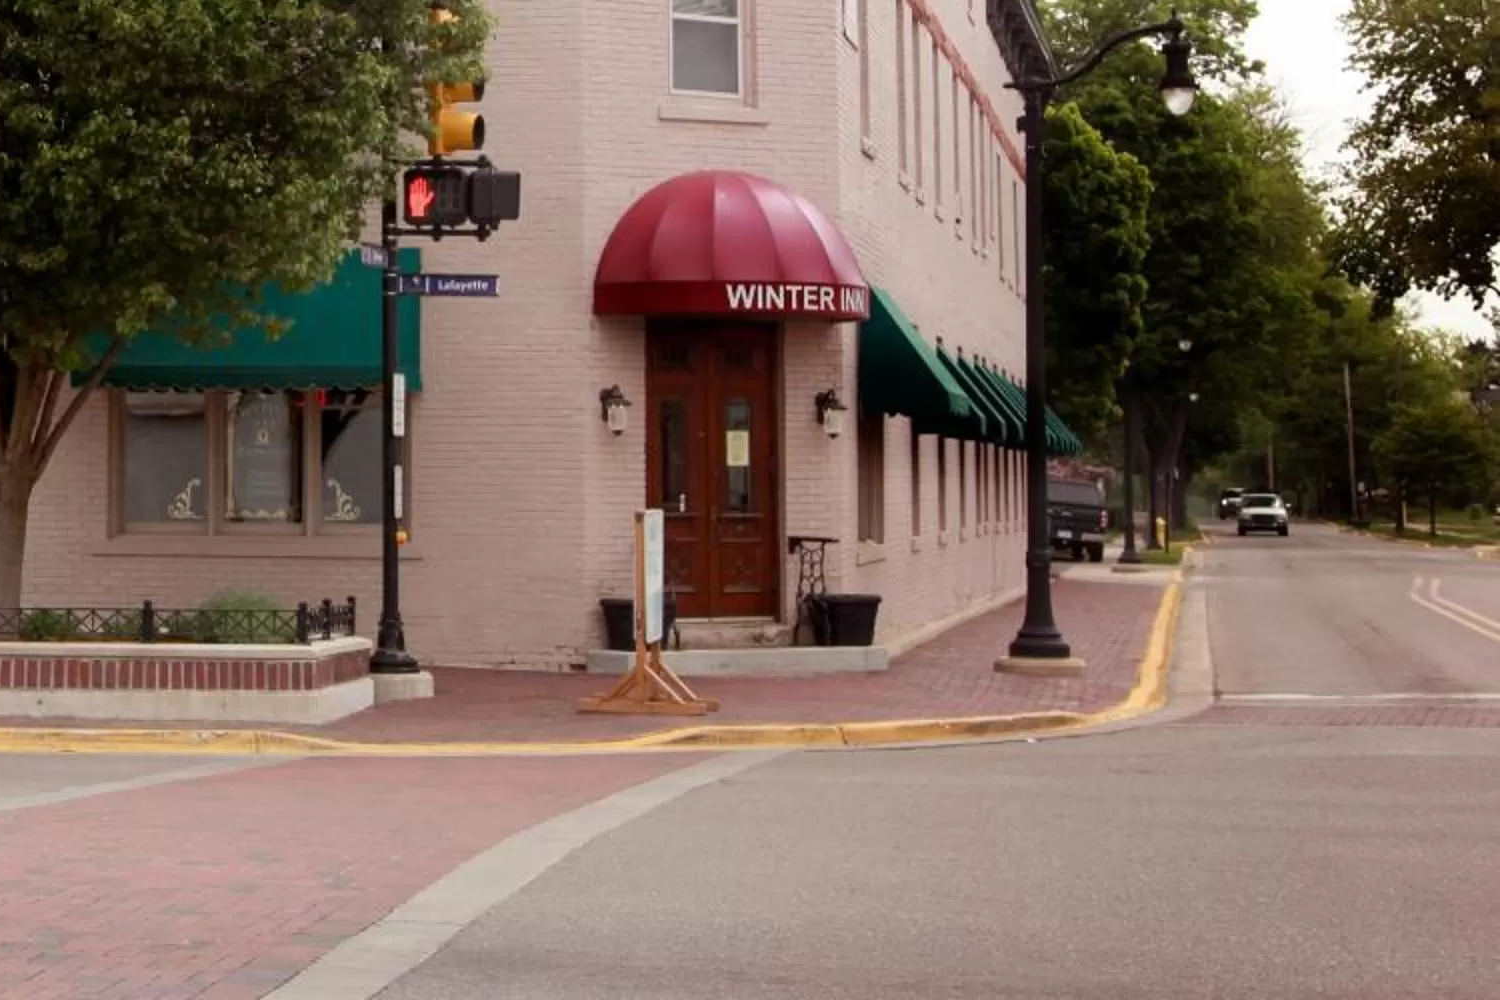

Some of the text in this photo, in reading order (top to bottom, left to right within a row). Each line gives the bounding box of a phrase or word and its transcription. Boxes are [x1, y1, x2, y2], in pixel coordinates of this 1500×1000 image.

[437, 280, 489, 293] Lafayette
[725, 284, 866, 313] WINTER INN
